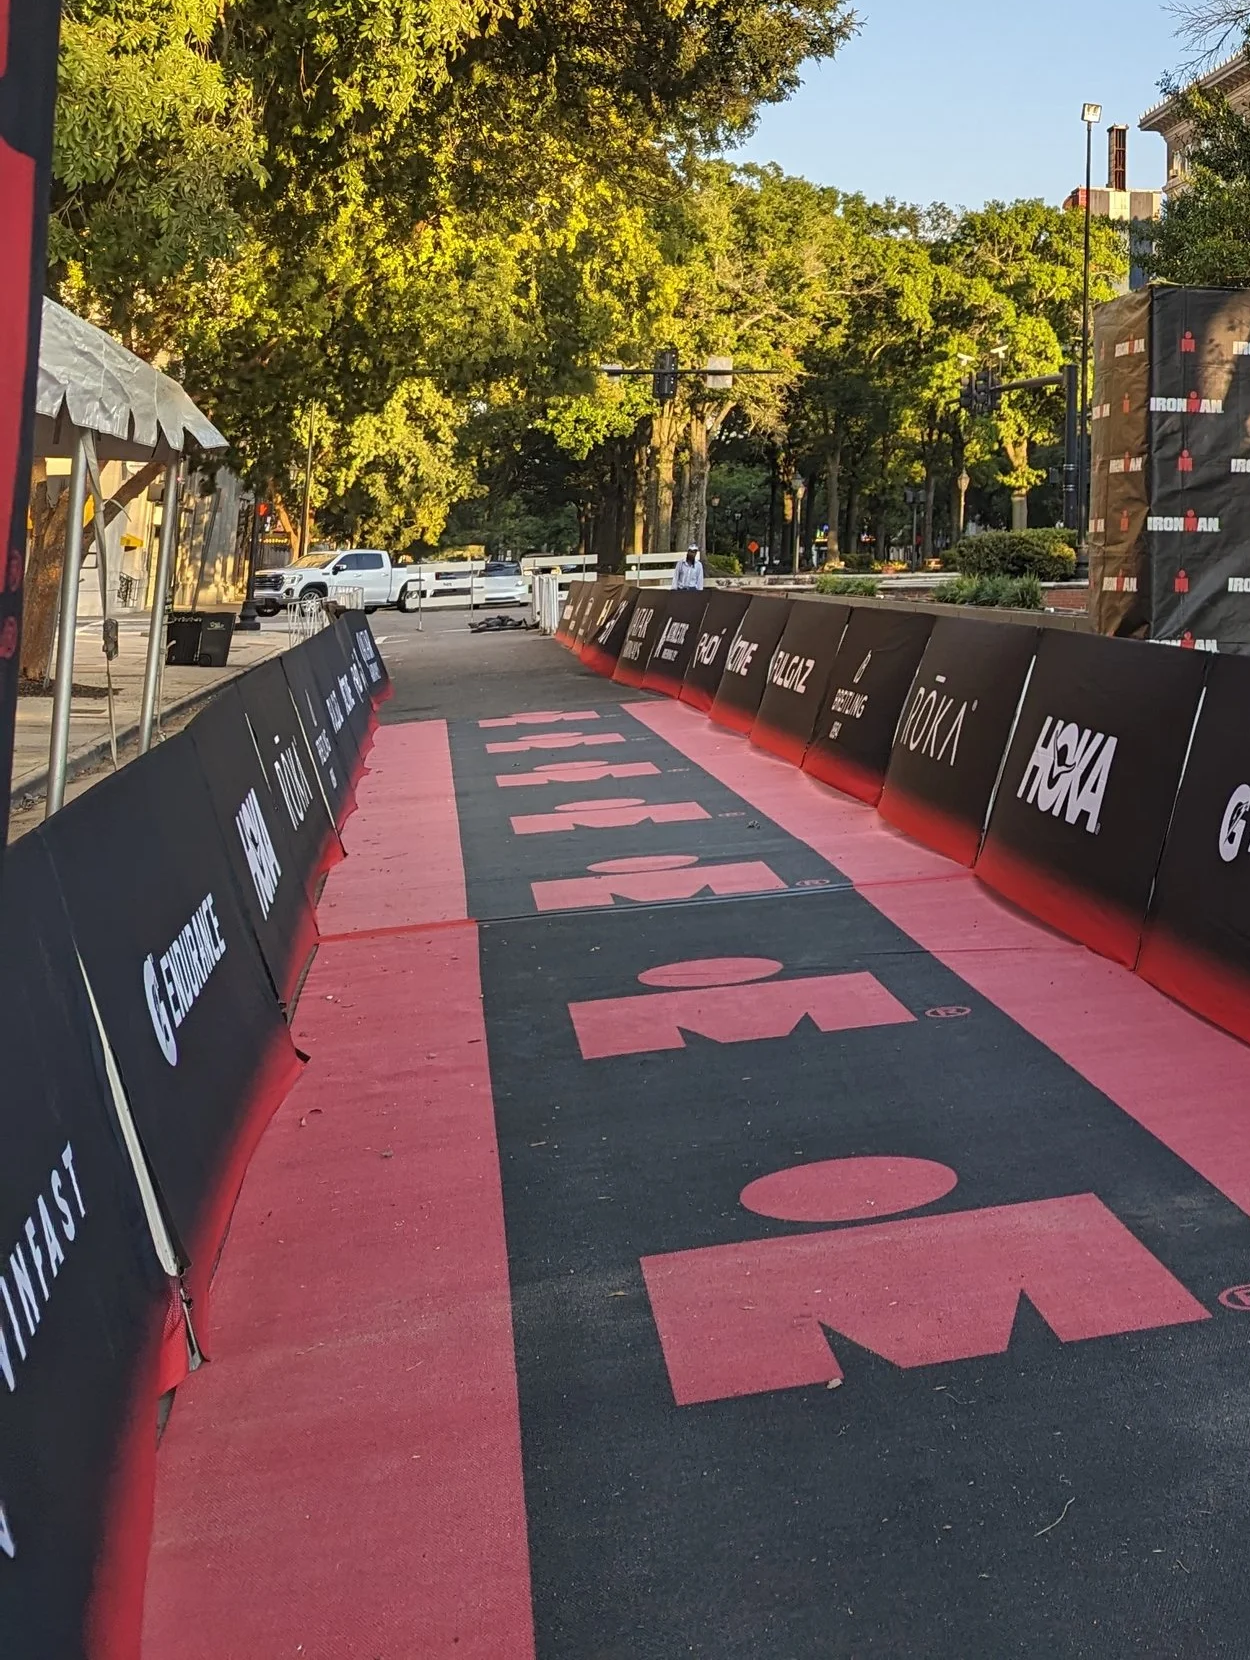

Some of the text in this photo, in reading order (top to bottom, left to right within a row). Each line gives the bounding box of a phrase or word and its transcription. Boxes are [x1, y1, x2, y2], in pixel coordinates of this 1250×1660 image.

[1150, 391, 1223, 414] IRONMAN
[1147, 509, 1220, 532] IRONMAN
[1016, 715, 1118, 835] HOKA
[159, 893, 226, 1028] ENDURANCE
